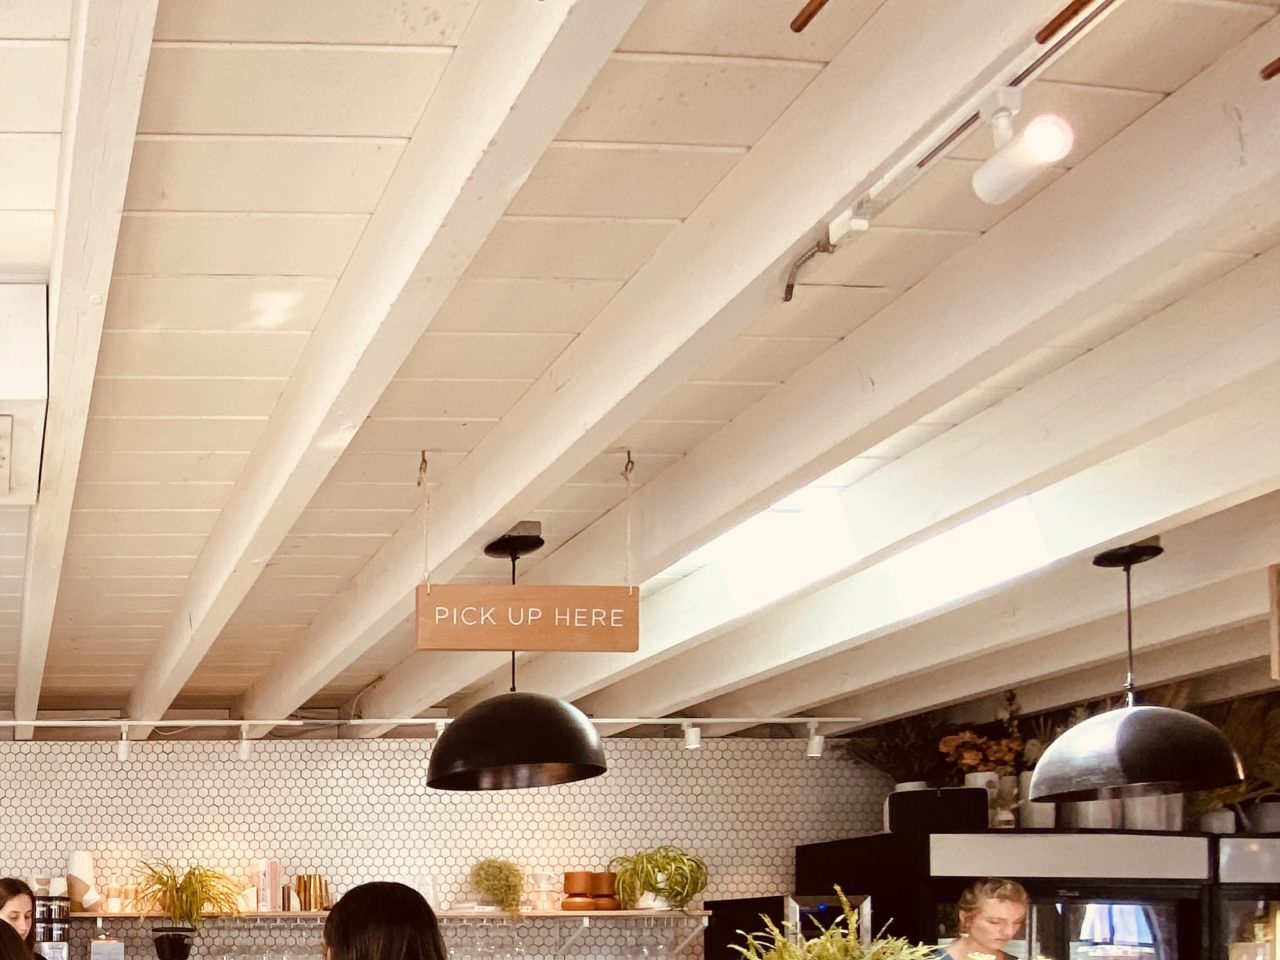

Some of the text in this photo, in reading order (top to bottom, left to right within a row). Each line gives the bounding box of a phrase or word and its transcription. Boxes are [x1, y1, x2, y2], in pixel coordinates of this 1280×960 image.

[434, 606, 625, 628] PICK UP HERE
